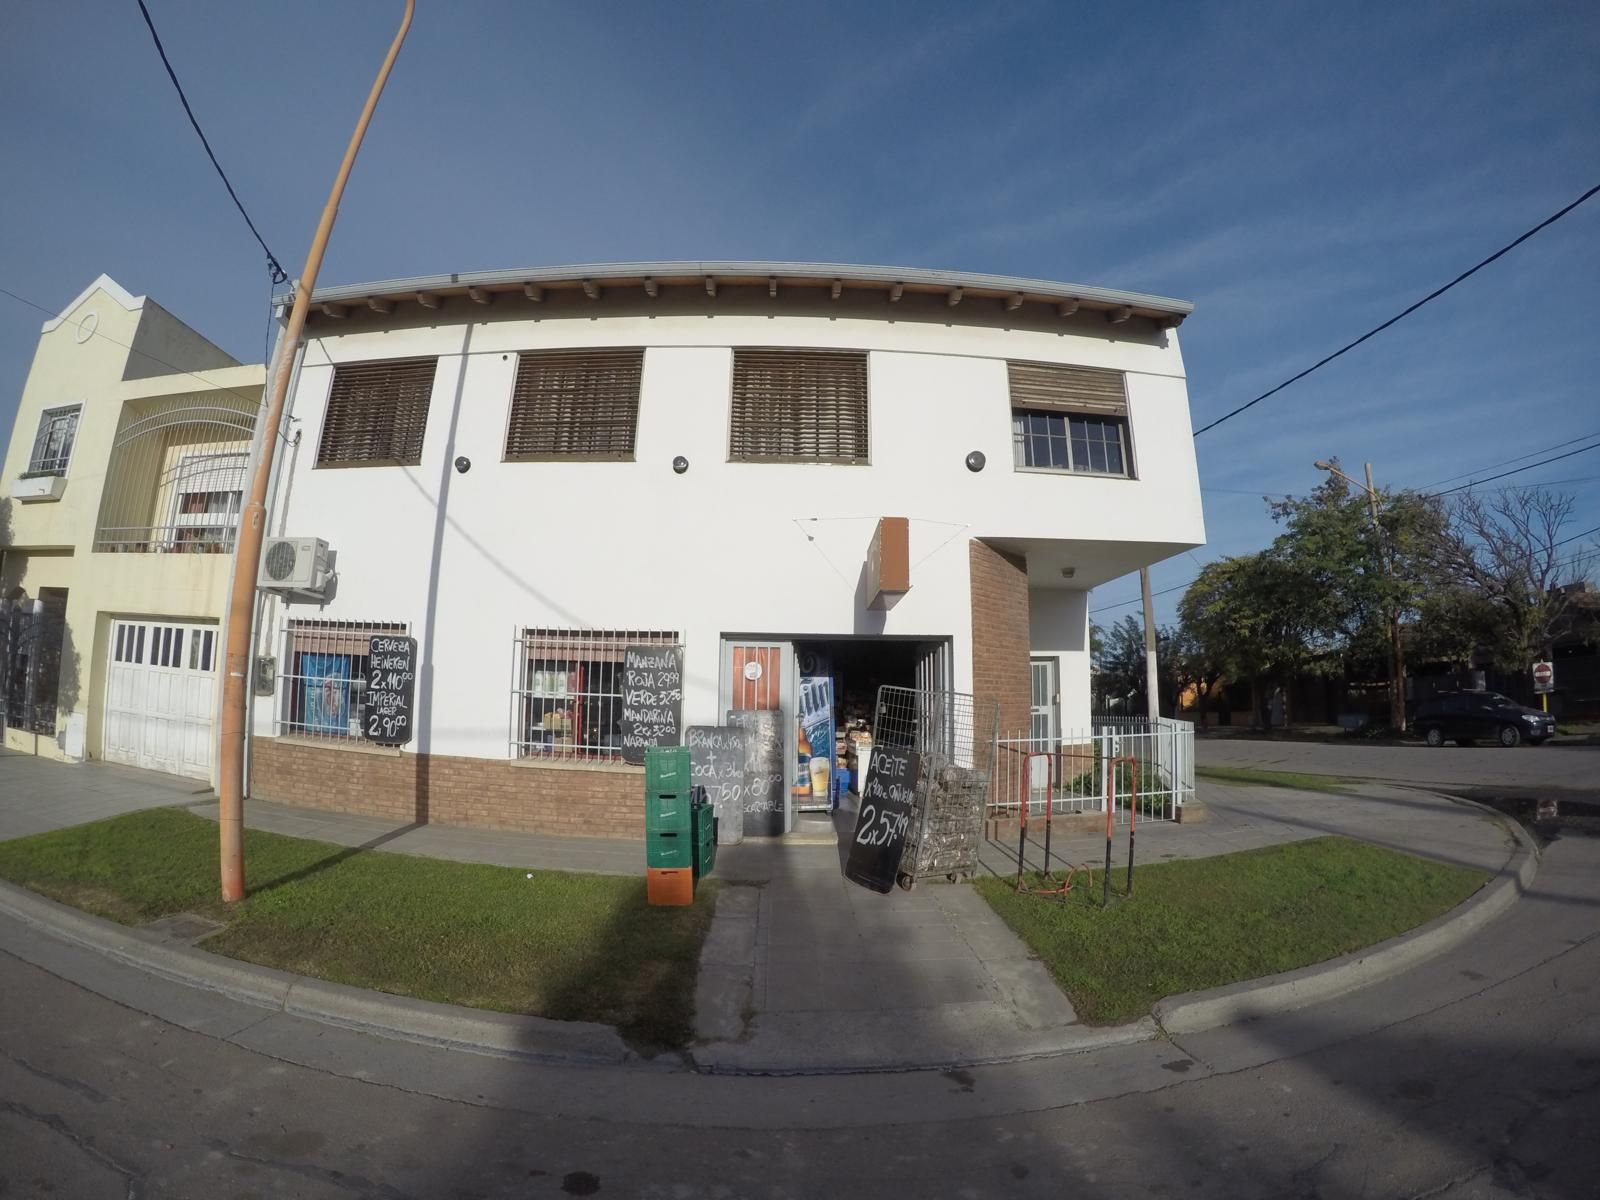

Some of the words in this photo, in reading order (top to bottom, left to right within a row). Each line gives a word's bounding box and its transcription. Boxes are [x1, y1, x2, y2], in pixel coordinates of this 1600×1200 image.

[371, 638, 410, 655] CERVEZA
[627, 650, 677, 672] MANZANA
[627, 670, 655, 689] ROJA
[625, 689, 657, 706] VERDE
